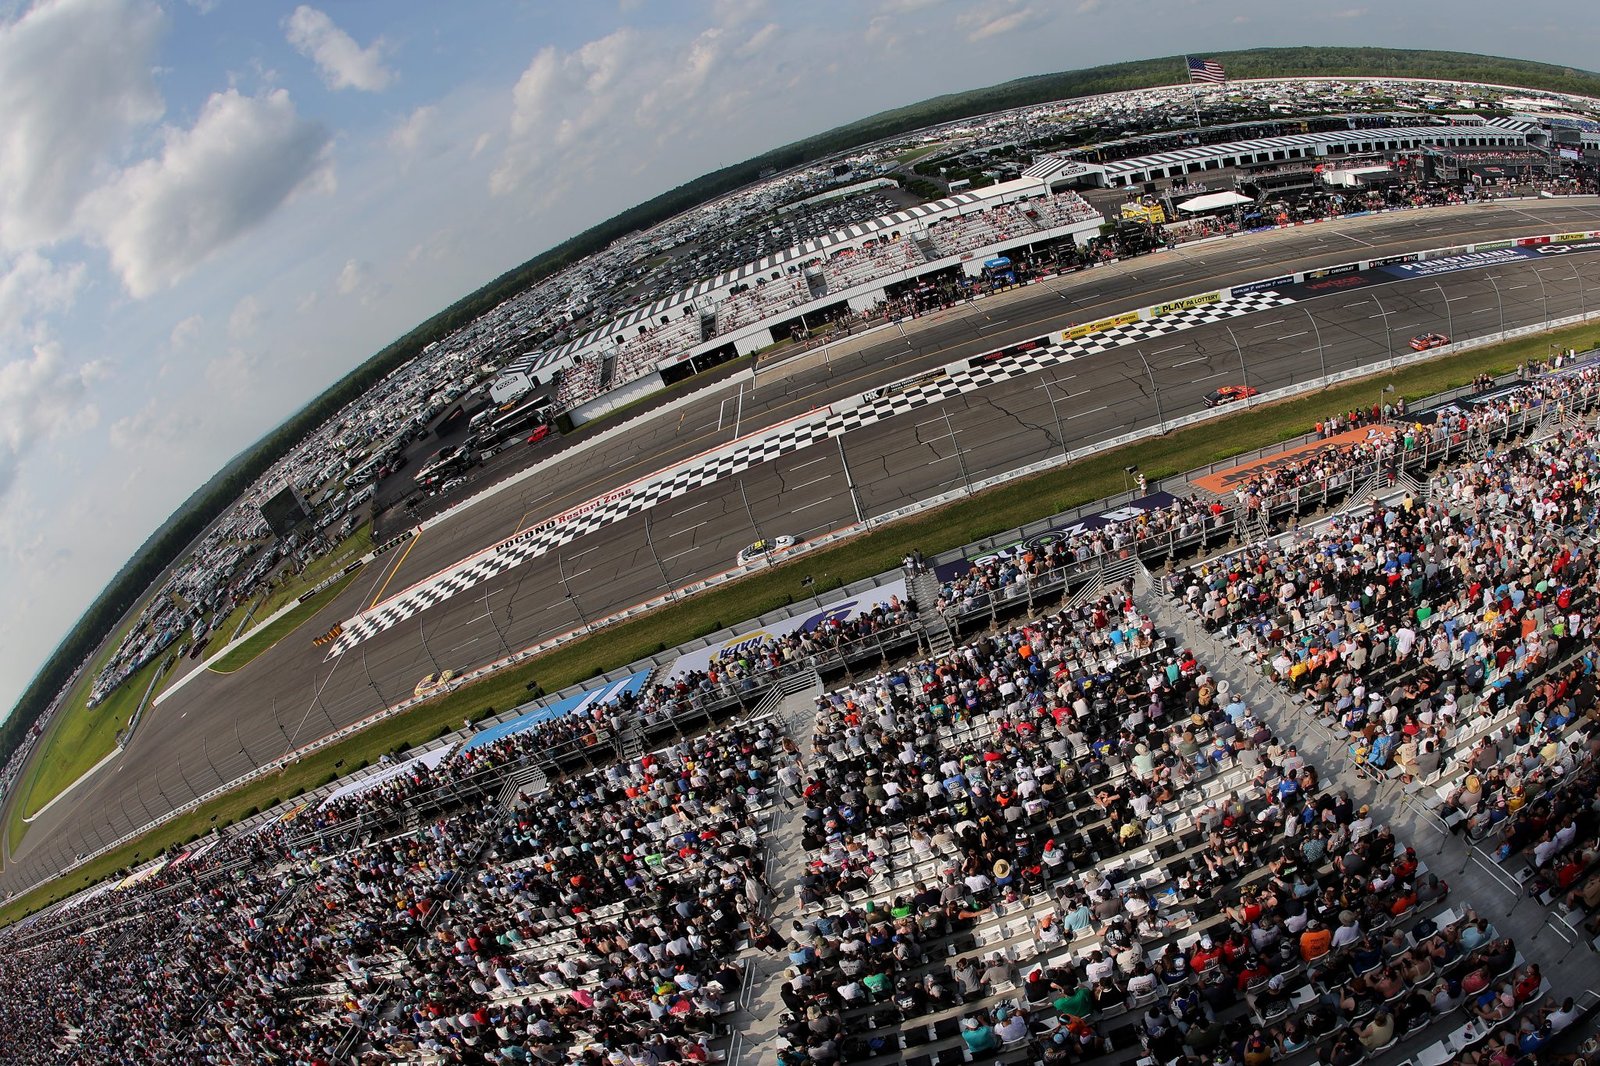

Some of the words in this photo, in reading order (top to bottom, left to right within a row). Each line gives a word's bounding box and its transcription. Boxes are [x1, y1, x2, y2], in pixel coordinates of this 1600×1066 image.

[1062, 166, 1087, 176] POCONO
[1400, 249, 1518, 271] PENNSYLVANIA
[1331, 266, 1354, 274] CHEVROLET
[1162, 300, 1185, 312] PLAY
[1186, 297, 1195, 306] PA
[1195, 293, 1219, 304] LOTTERY
[1016, 341, 1036, 351] verizon
[983, 351, 1003, 361] verizon
[497, 376, 517, 391] POCONO
[495, 520, 556, 553] POCONO
[558, 501, 601, 523] Restart
[603, 487, 632, 504] Zone
[719, 635, 764, 660] NAPA
